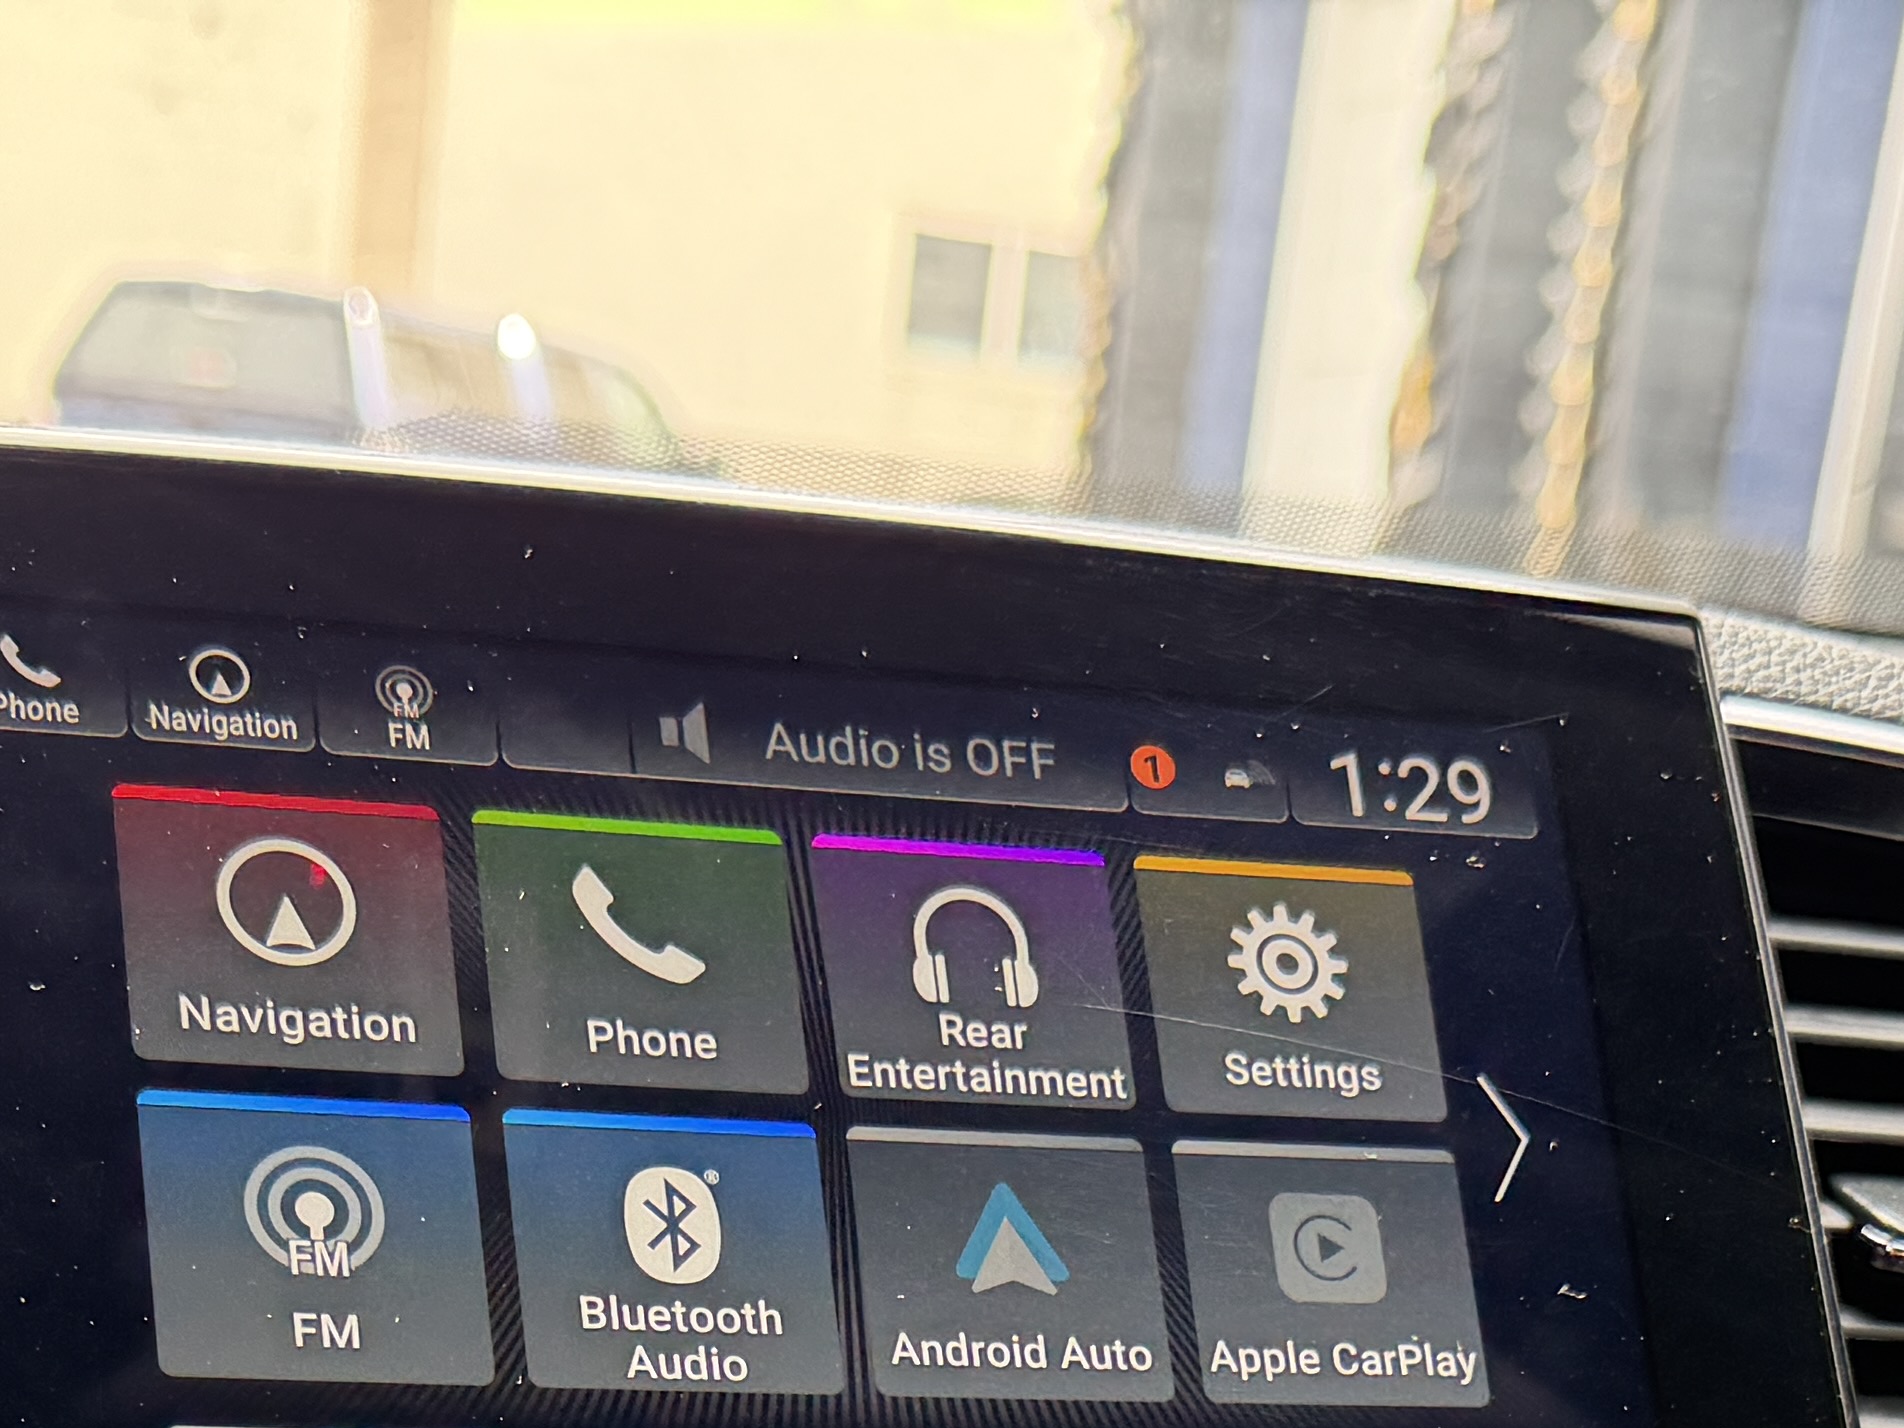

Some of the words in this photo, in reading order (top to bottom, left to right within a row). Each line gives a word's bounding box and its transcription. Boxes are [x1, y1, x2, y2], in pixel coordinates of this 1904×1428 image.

[149, 703, 299, 742] Navigation
[388, 723, 430, 750] FM
[765, 722, 906, 770] Audio
[916, 728, 954, 774] is
[966, 736, 1057, 781] OFF
[1143, 754, 1161, 784] 1
[1329, 751, 1493, 825] 1:29
[177, 992, 417, 1046] Navigation
[586, 1018, 719, 1061] Phone
[938, 1012, 1029, 1053] Rear
[847, 1052, 1128, 1101] Entertainment
[1224, 1051, 1383, 1097] Settings
[288, 1239, 352, 1279] FM
[293, 1311, 362, 1350] FM
[579, 1294, 784, 1337] Bluetooth
[626, 1344, 749, 1382] Audio
[891, 1331, 1048, 1371] Android
[1061, 1337, 1154, 1373] Auto
[1210, 1339, 1321, 1382] Apple
[1332, 1340, 1478, 1387] CarPlay
